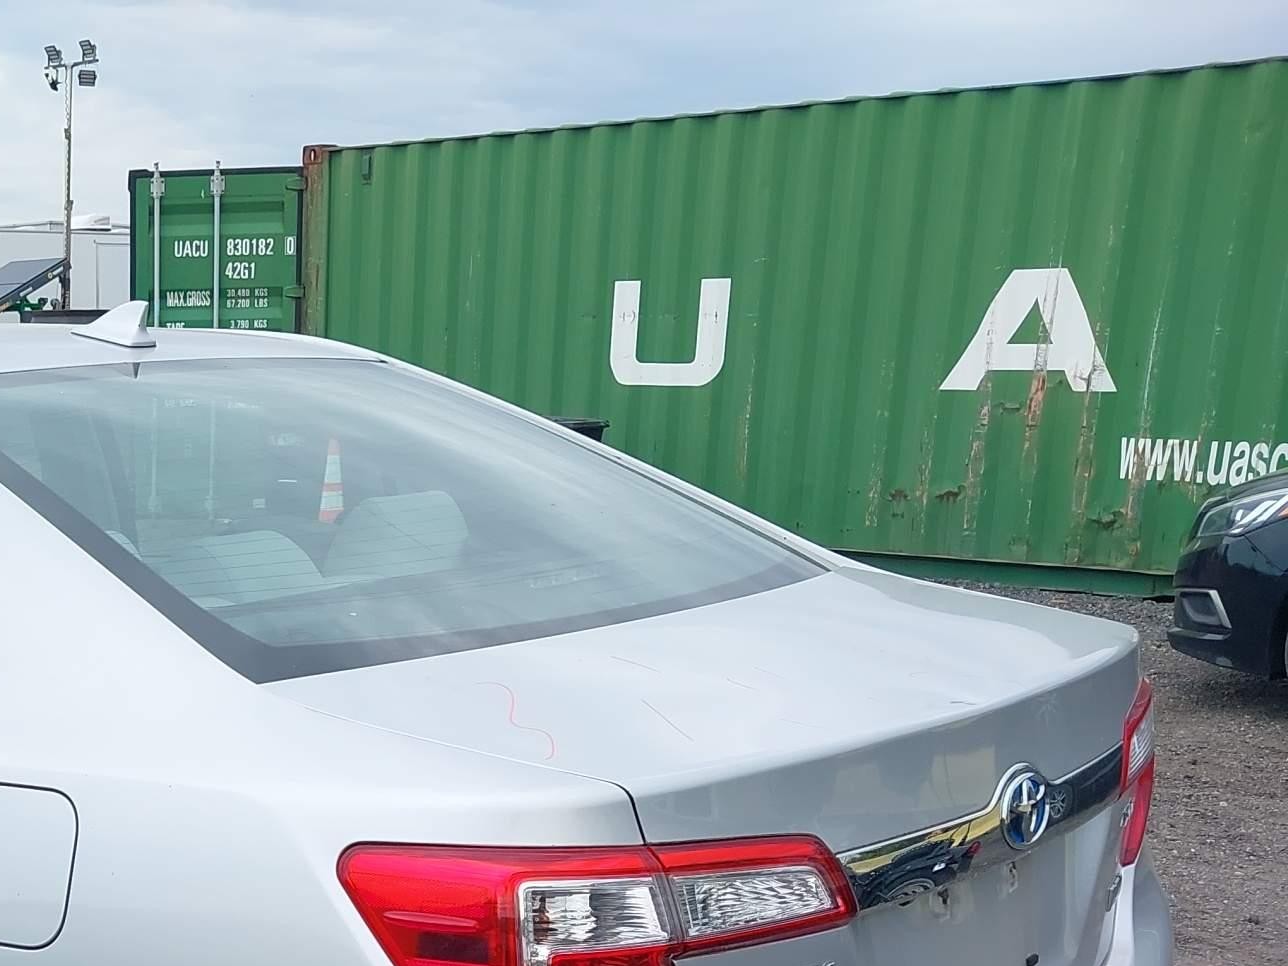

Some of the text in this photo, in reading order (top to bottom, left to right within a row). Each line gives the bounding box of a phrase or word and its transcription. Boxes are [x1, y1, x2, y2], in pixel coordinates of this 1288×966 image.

[174, 240, 209, 257] UACU
[226, 238, 274, 256] 830182
[225, 262, 255, 279] 42G1
[166, 291, 211, 307] MAX.GROSS
[254, 288, 268, 296] KGS
[254, 299, 268, 308] LBS
[253, 319, 268, 328] KGS
[610, 267, 1118, 394] U A
